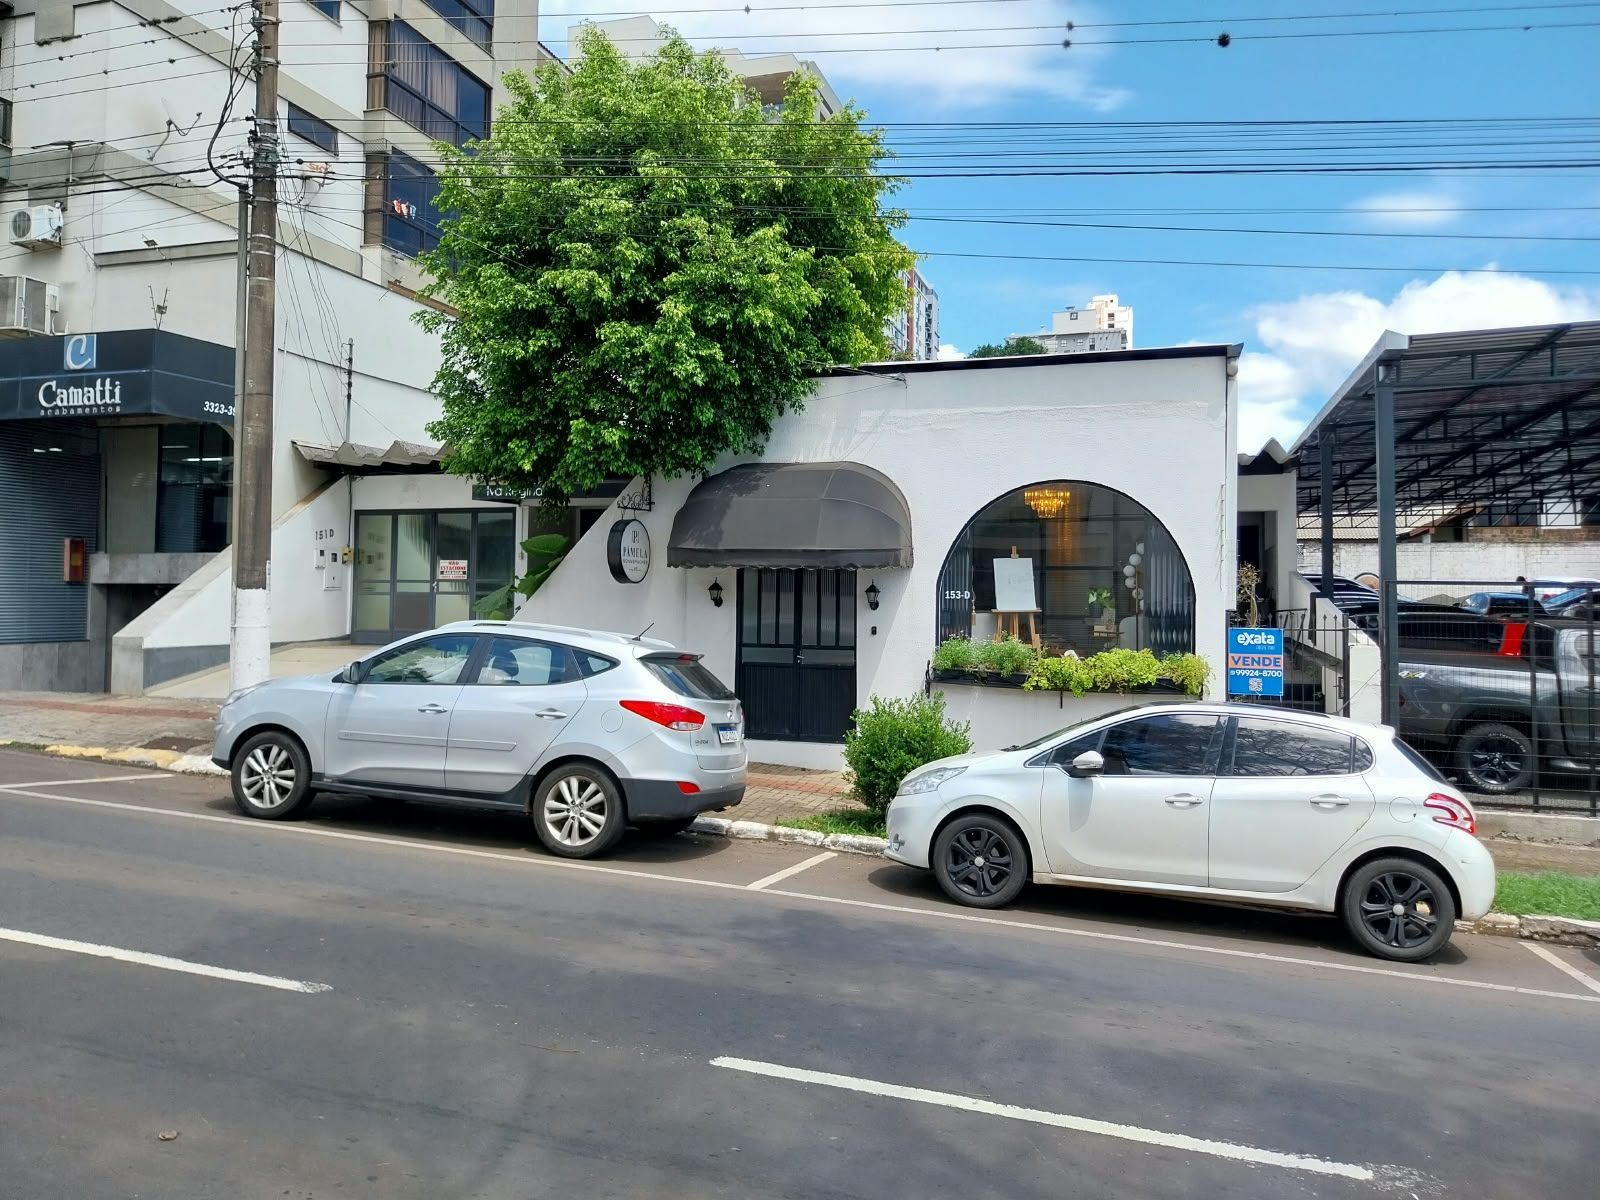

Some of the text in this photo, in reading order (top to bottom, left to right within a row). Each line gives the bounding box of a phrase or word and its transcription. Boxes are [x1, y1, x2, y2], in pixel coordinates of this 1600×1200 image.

[38, 377, 121, 408] Camatti
[39, 406, 121, 416] acabamentos
[945, 590, 971, 600] 153-D
[1231, 655, 1282, 668] VENDE
[1235, 669, 1283, 678] 99924-8700
